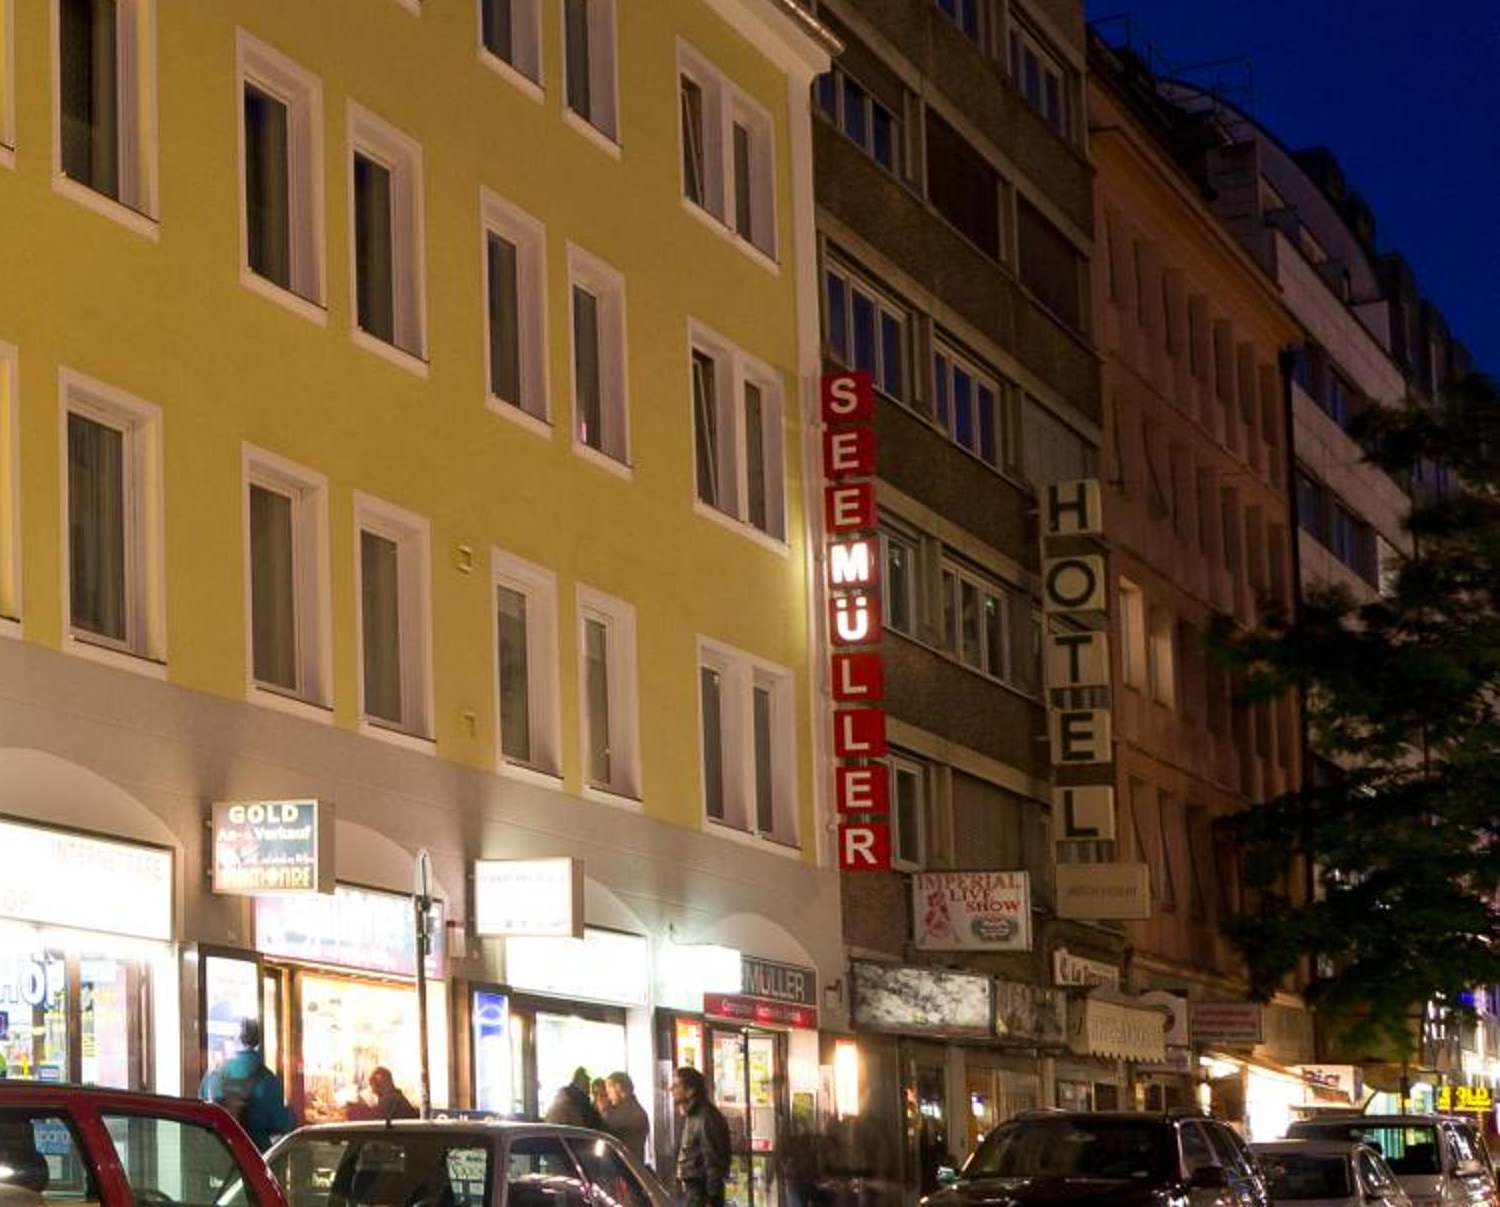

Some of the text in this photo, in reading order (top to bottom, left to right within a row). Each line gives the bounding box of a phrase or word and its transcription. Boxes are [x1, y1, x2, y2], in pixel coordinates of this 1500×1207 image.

[829, 377, 878, 865] SEEMÜLLER
[1045, 482, 1099, 838] HOTEL
[228, 804, 299, 824] GOLD
[919, 873, 1022, 889] IMPERIAL
[948, 889, 994, 902] LIVE
[965, 900, 1019, 912] SHOW
